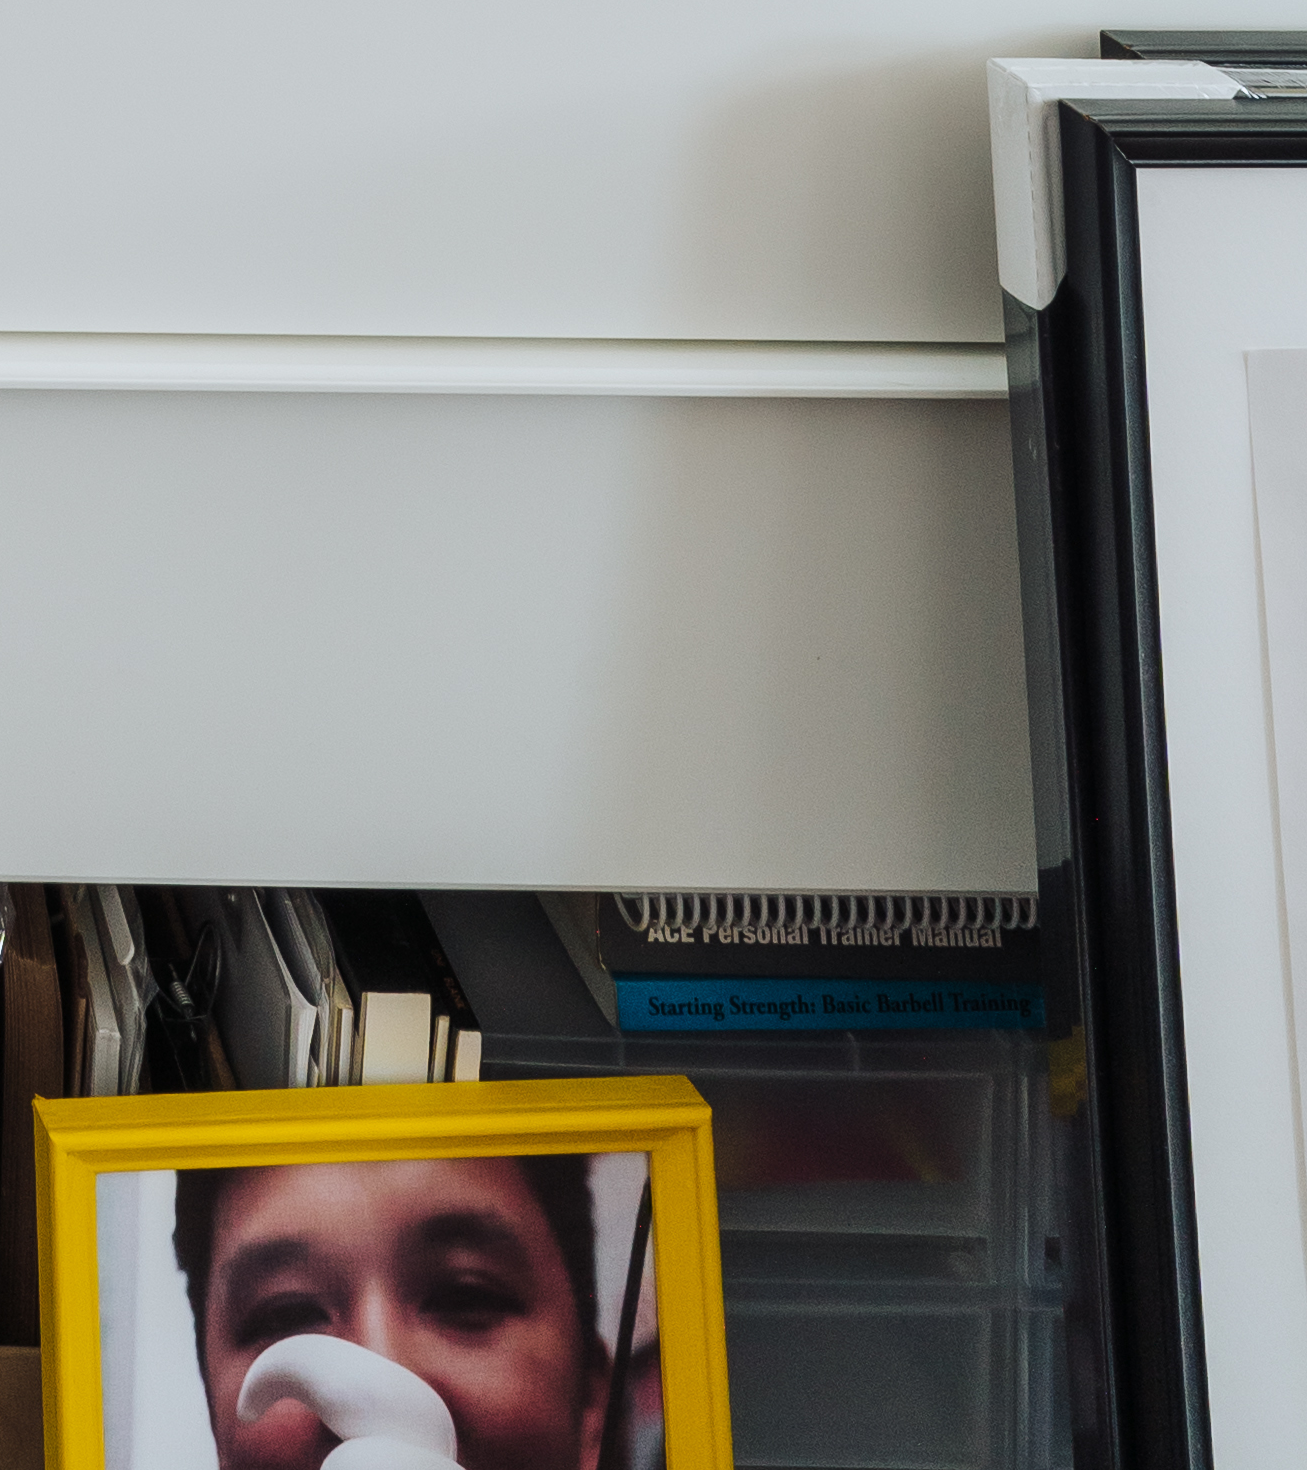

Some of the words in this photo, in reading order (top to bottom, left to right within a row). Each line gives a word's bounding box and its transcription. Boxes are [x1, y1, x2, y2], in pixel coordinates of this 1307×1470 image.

[647, 921, 695, 943] ACE
[703, 923, 809, 945] Personal
[819, 923, 904, 946] Trainer
[912, 925, 1003, 948] Manual
[648, 996, 726, 1022] Starting
[729, 994, 816, 1020] Strength:
[822, 994, 871, 1015] Basic
[877, 992, 945, 1014] Barbell
[949, 991, 1032, 1018] Training
